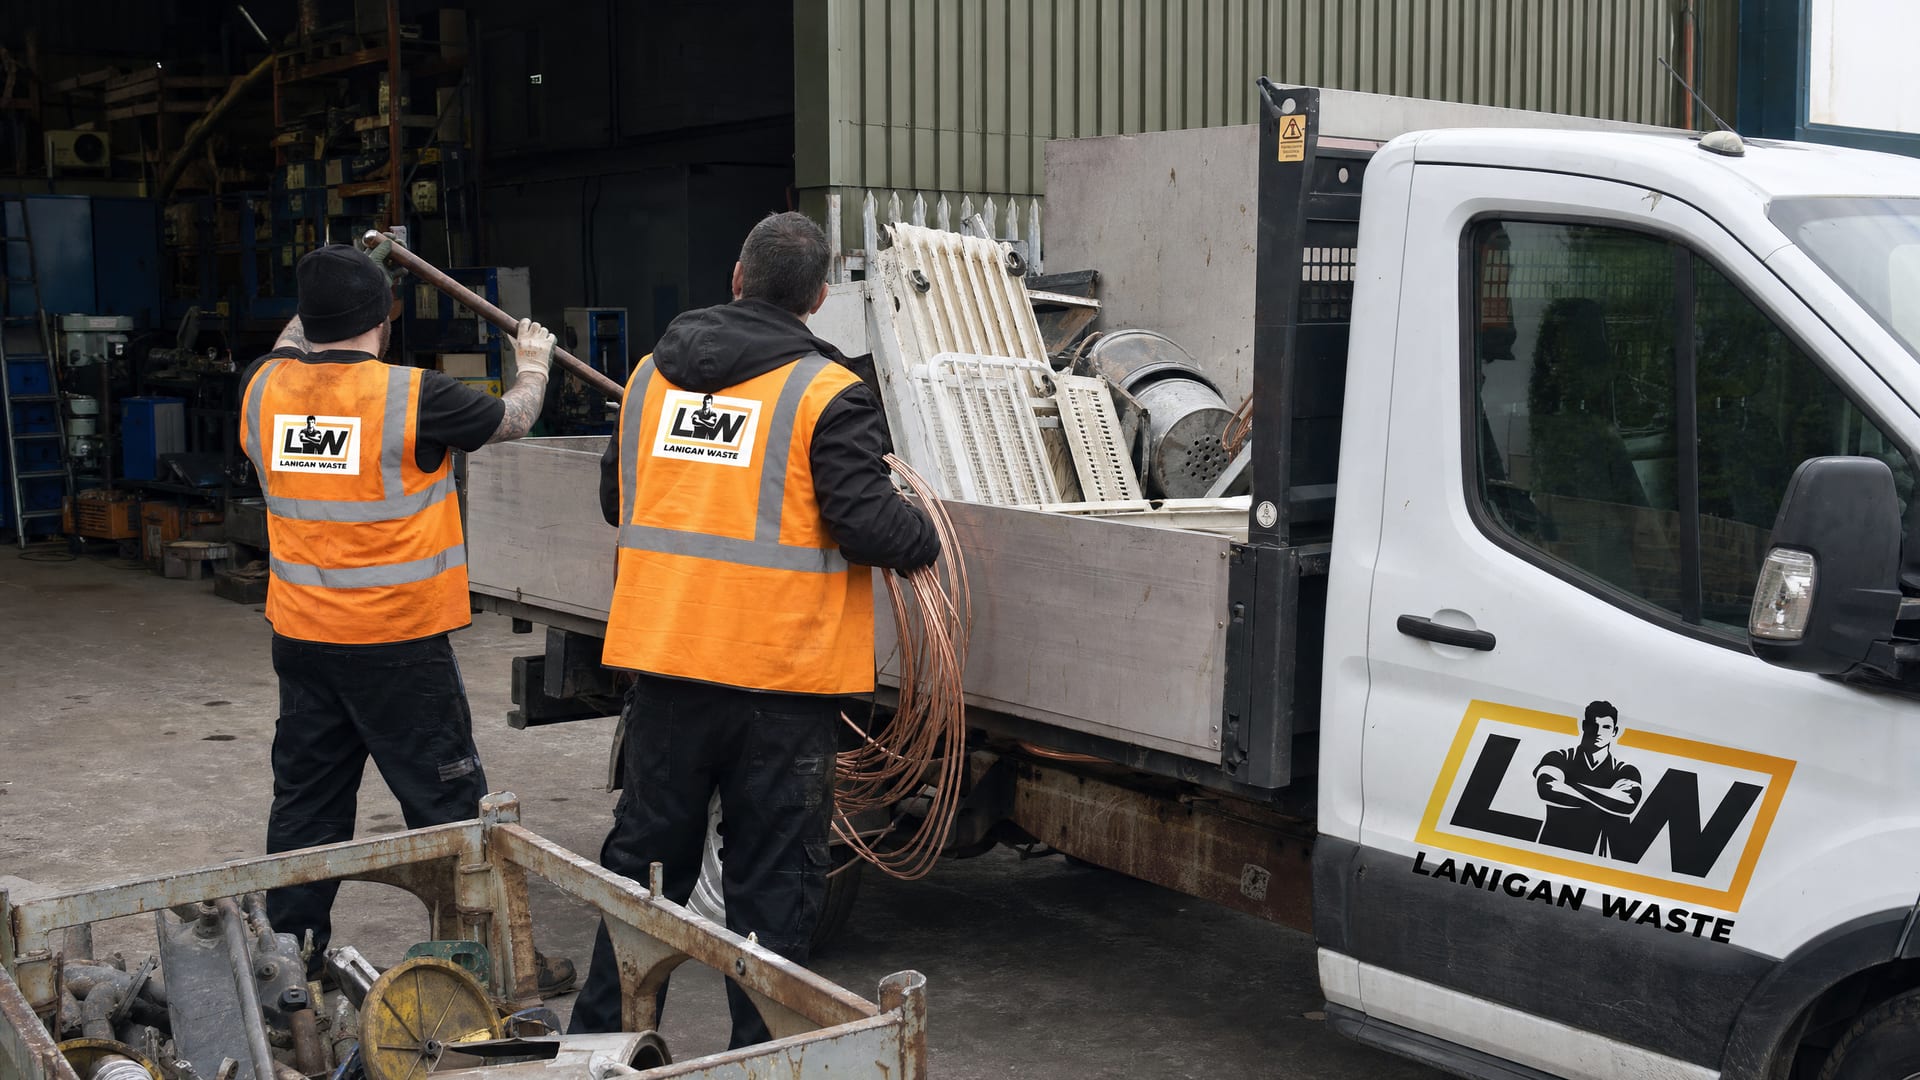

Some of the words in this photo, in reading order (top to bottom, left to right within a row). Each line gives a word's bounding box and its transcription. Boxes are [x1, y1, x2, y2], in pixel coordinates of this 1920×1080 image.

[663, 444, 705, 455] LANIGAN
[707, 450, 739, 460] WASTE
[279, 460, 316, 468] LANIGAN
[1411, 851, 1587, 911] LANIGAN
[1601, 893, 1735, 944] WASTE
